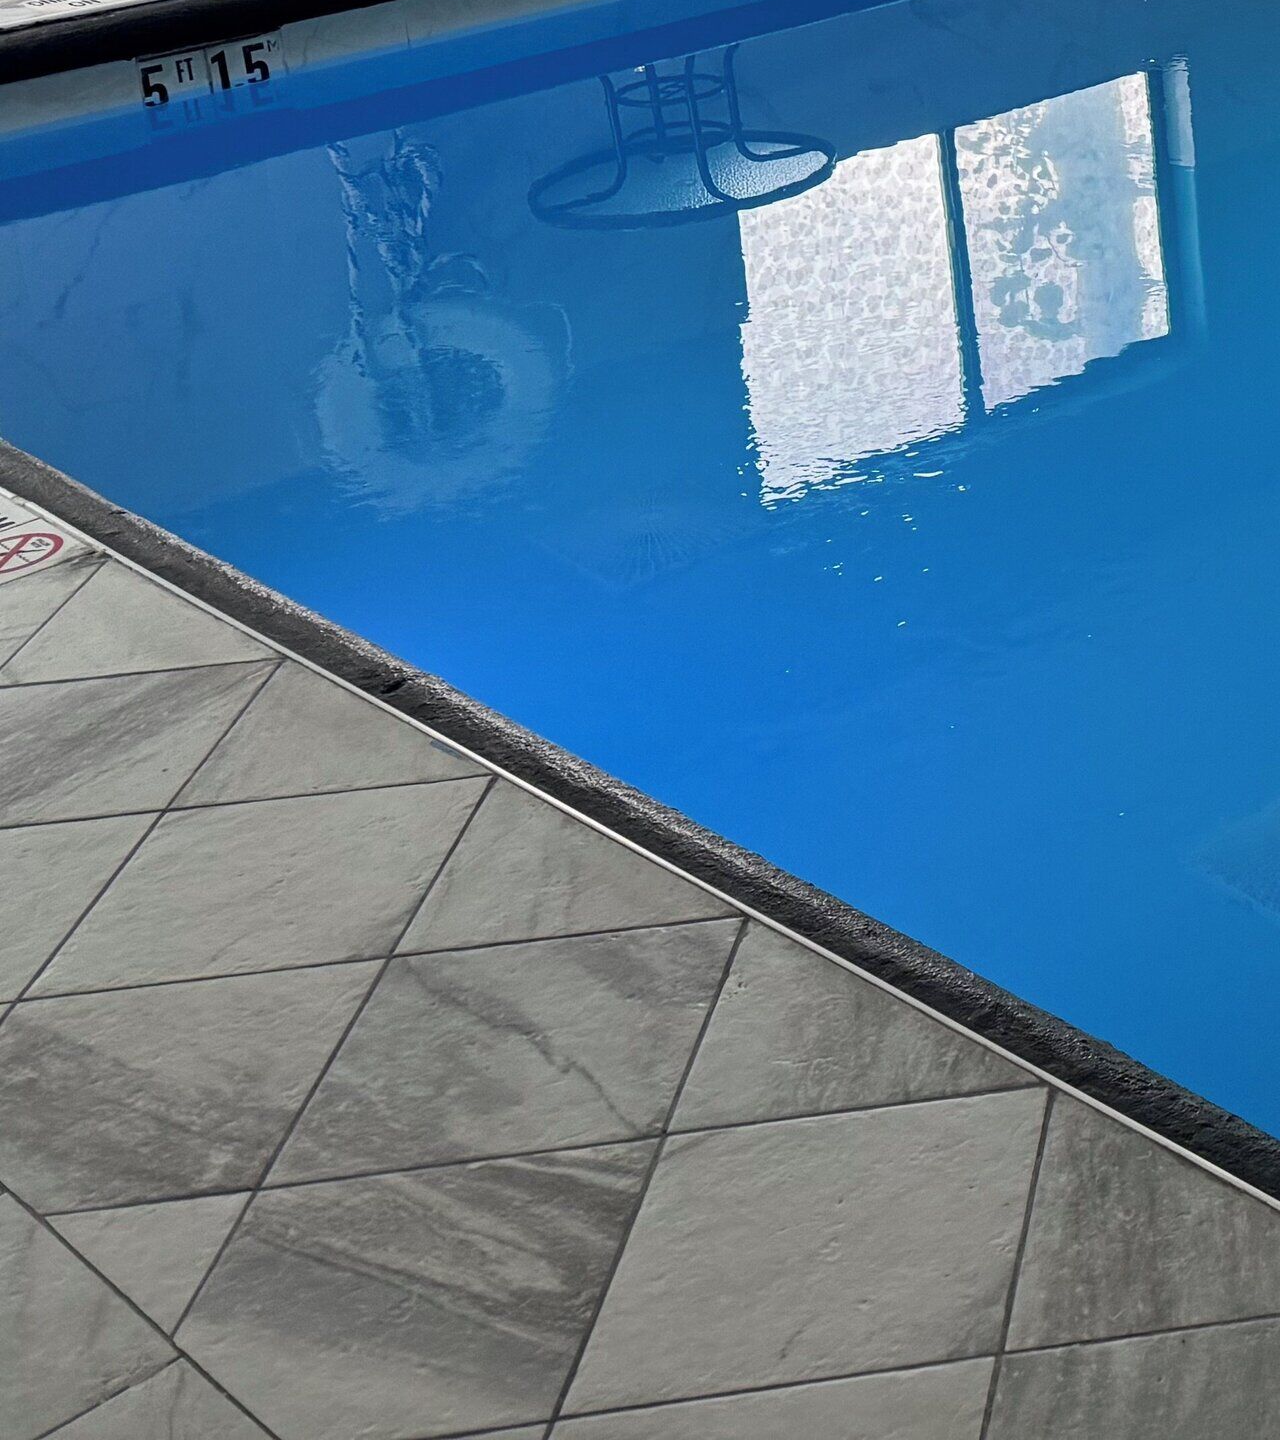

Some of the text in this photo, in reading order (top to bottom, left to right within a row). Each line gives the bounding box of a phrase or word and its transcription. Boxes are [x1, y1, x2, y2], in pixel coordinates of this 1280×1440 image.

[140, 64, 169, 107] 5
[175, 58, 194, 83] FT
[267, 40, 277, 52] M
